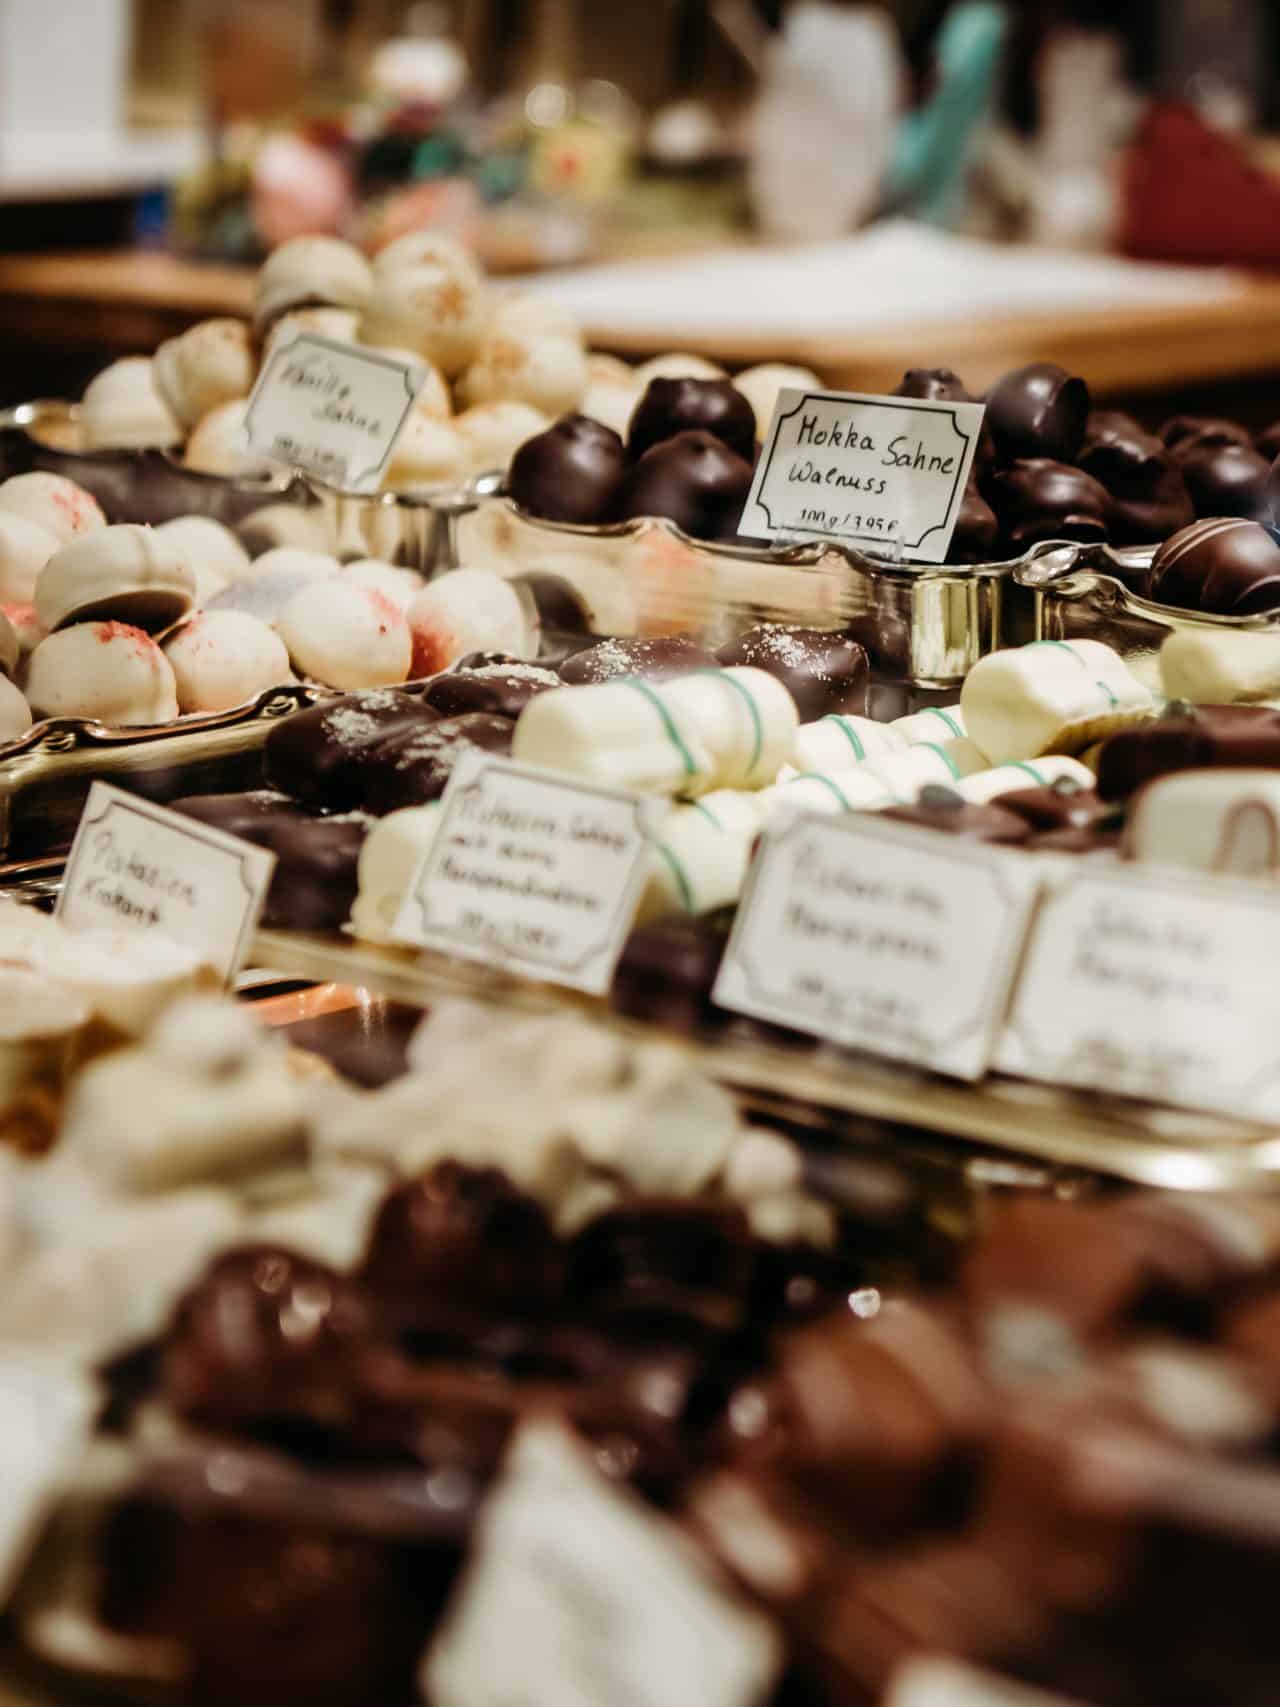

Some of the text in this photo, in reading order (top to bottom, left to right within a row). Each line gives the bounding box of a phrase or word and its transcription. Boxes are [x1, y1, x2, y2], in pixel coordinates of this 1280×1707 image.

[797, 414, 954, 475] Mokka Sahne
[788, 462, 888, 495] Walnuss
